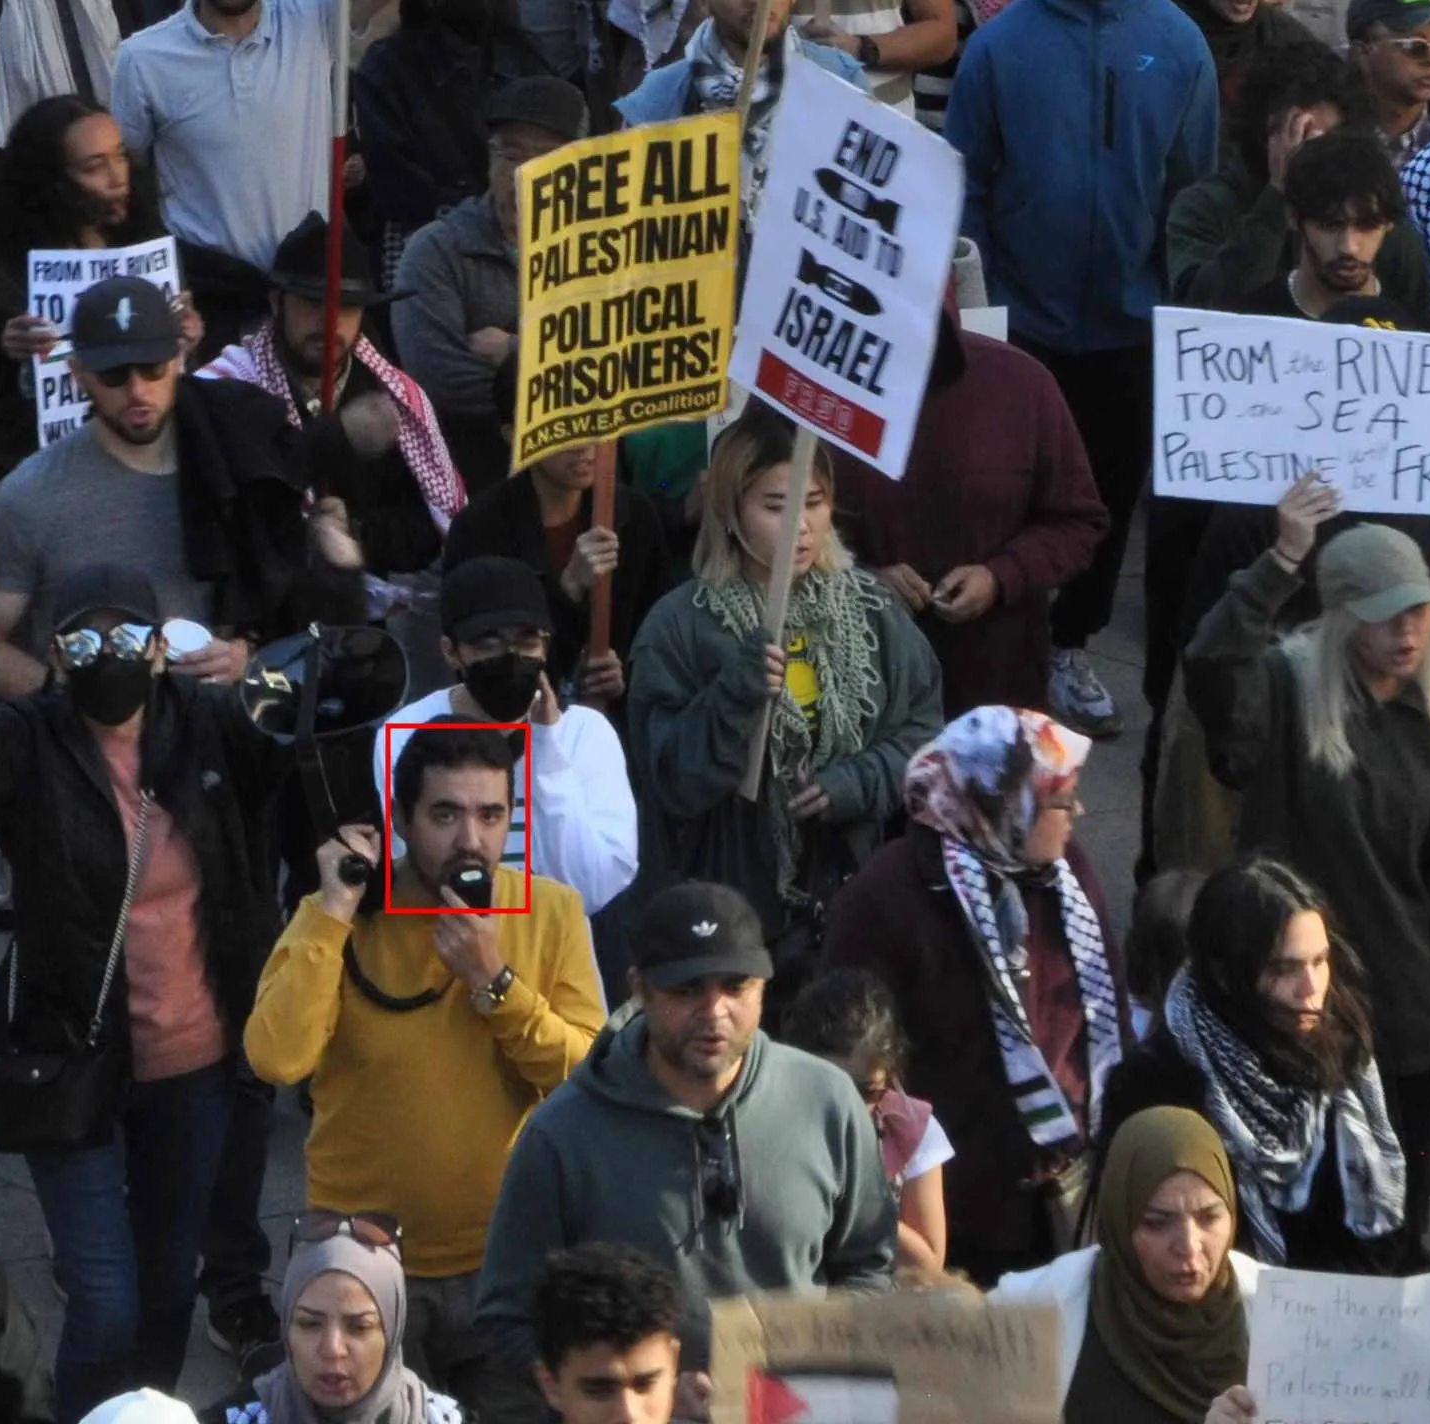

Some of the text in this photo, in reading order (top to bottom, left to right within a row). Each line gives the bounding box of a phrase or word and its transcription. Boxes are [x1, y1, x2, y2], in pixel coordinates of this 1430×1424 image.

[530, 132, 731, 244] FREE ALL
[833, 119, 903, 189] END
[528, 205, 730, 302] PALESTINIAN
[792, 186, 905, 279] U.S. AID TO
[33, 259, 82, 283] FROM
[88, 258, 120, 278] THE
[33, 294, 64, 325] TO
[538, 278, 706, 364] POLITICAL
[772, 285, 894, 398] ISRAEL
[526, 327, 721, 425] PRISONERS!
[1175, 326, 1279, 384] FROM
[1283, 351, 1327, 377] the
[629, 387, 718, 420] Coalition
[1175, 392, 1228, 422] TO
[1295, 390, 1410, 441] SEA
[1162, 430, 1340, 485] PALESTINE
[1351, 470, 1378, 490] be
